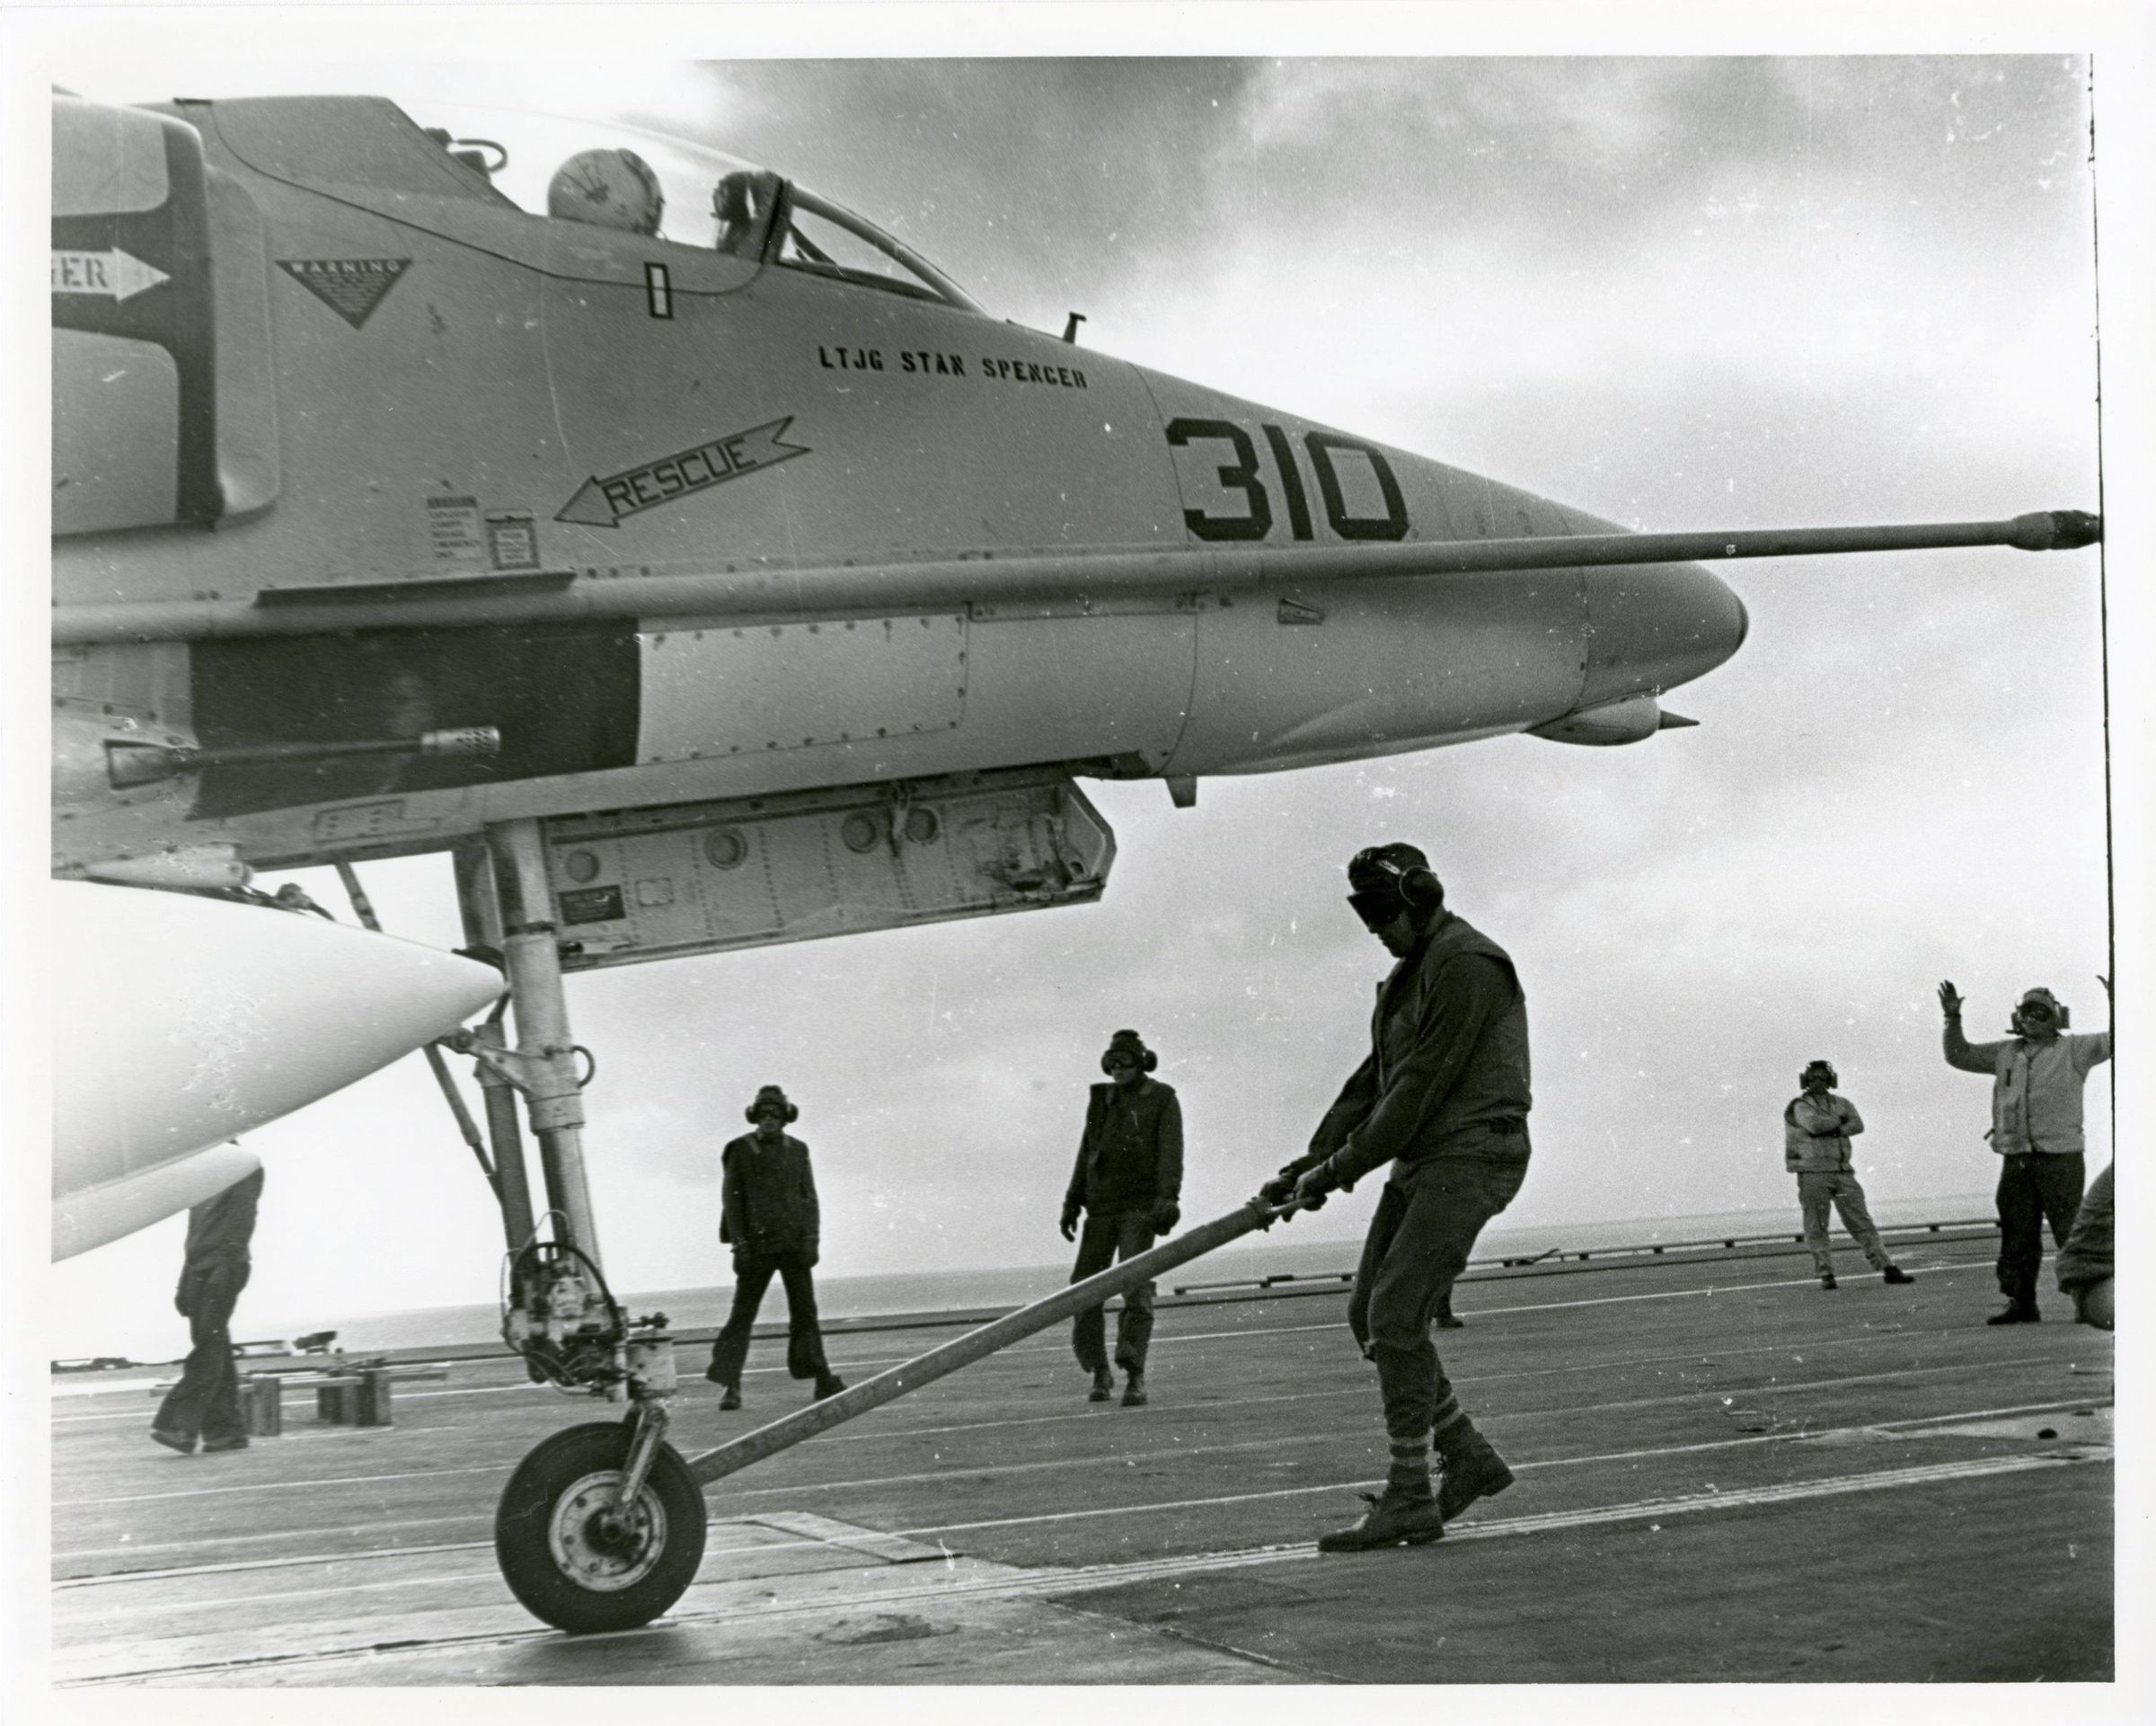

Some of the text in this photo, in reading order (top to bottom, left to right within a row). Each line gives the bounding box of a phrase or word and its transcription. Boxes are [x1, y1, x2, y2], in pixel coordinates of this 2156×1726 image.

[52, 257, 108, 287] ER
[290, 260, 401, 272] WARNING
[818, 346, 1088, 388] LTJG STAN SPENCER
[601, 438, 757, 514] RESCUE
[1165, 417, 1409, 541] 310
